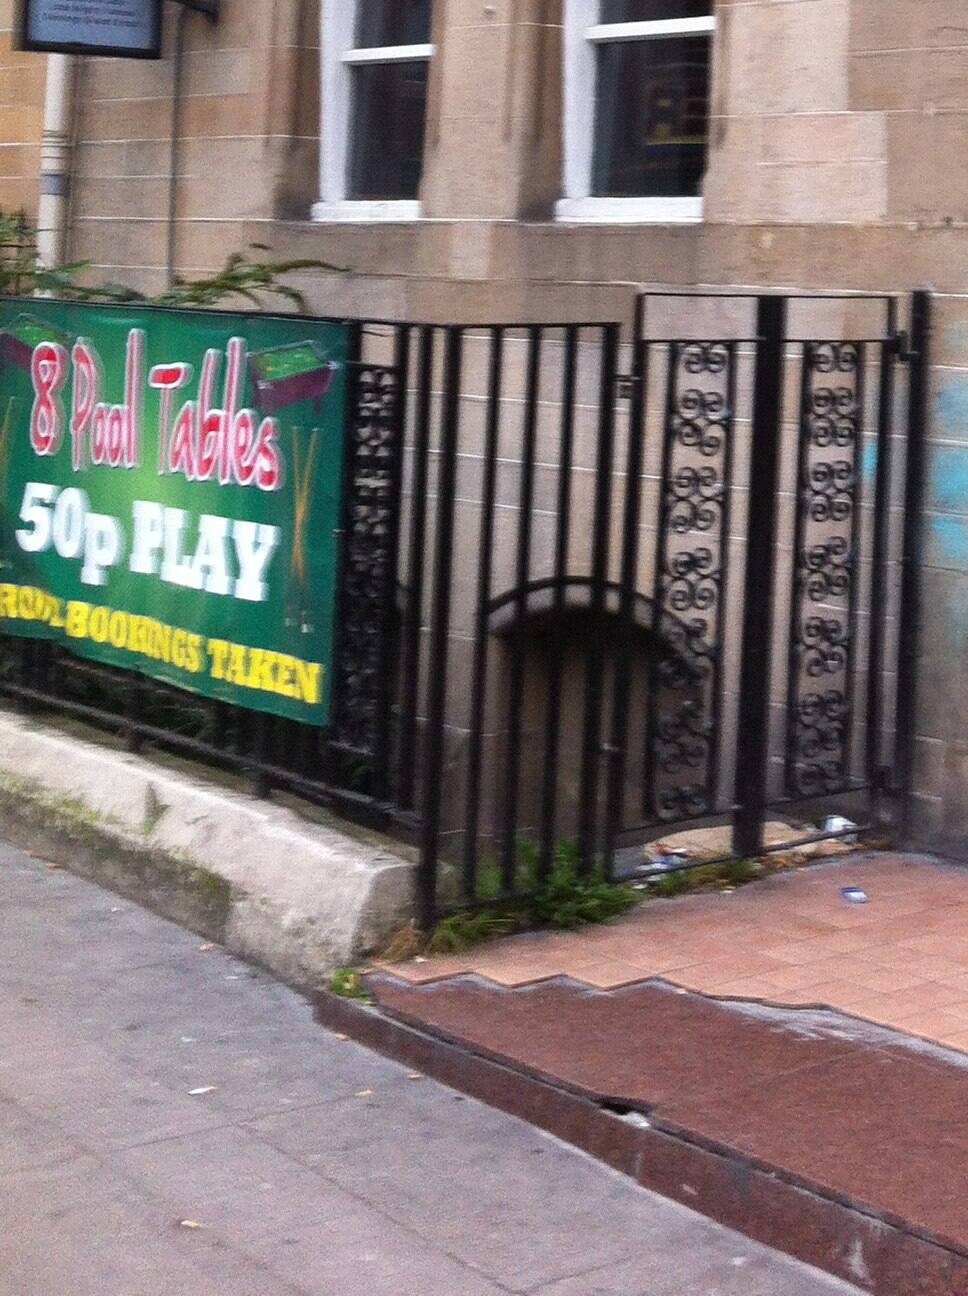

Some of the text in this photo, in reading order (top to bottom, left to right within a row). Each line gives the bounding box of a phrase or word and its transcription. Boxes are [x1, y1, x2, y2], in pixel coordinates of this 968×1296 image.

[30, 328, 285, 491] 8 Pool Tables
[15, 482, 281, 602] 50p PLAY
[65, 600, 204, 673] BOOKINGS
[207, 638, 325, 704] TAKEN
